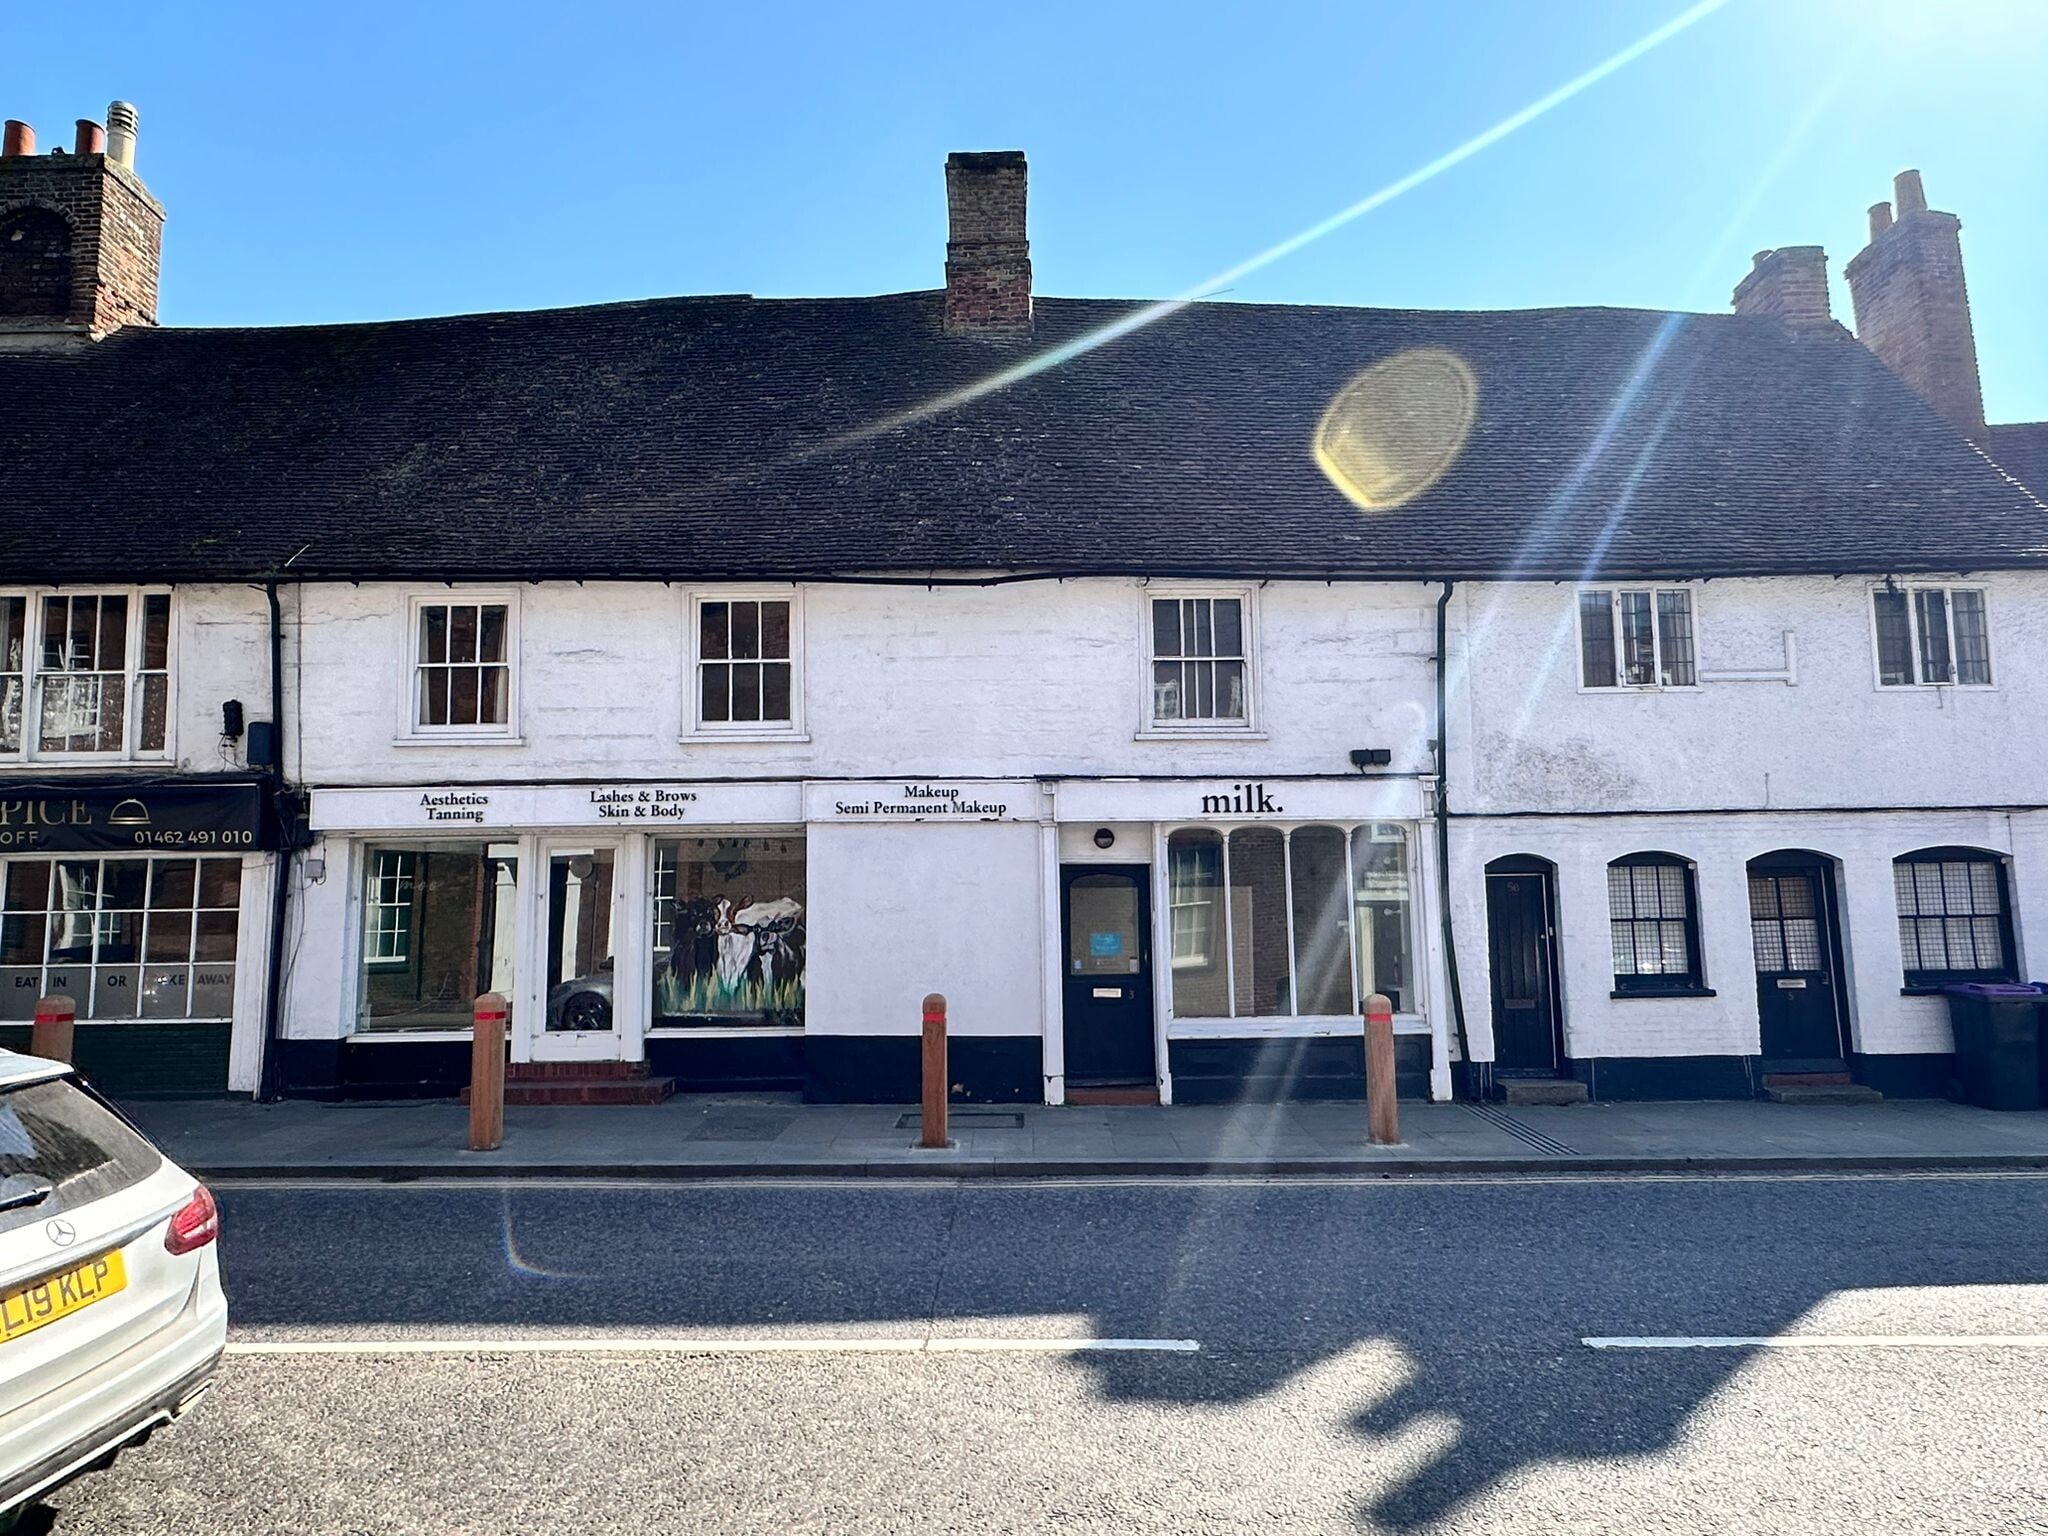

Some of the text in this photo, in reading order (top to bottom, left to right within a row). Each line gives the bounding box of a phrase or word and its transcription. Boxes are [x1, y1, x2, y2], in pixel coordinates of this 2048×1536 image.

[420, 793, 489, 806] Aesthetics
[590, 789, 697, 803] Lashes & Brows
[904, 785, 959, 801] Makeup
[1201, 783, 1284, 813] milk.
[426, 807, 483, 822] Tanning
[599, 803, 685, 819] Skin & Body
[835, 800, 1007, 817] Semi Permanent Makeup
[0, 831, 39, 844] OFF
[134, 830, 252, 844] 01462 491 010
[15, 976, 39, 988] EAT
[53, 976, 67, 987] IN
[107, 975, 126, 987] OR
[197, 974, 233, 985] AWAY
[1128, 990, 1135, 999] 3
[0, 1283, 52, 1333] L19
[57, 1260, 108, 1307] KLP
